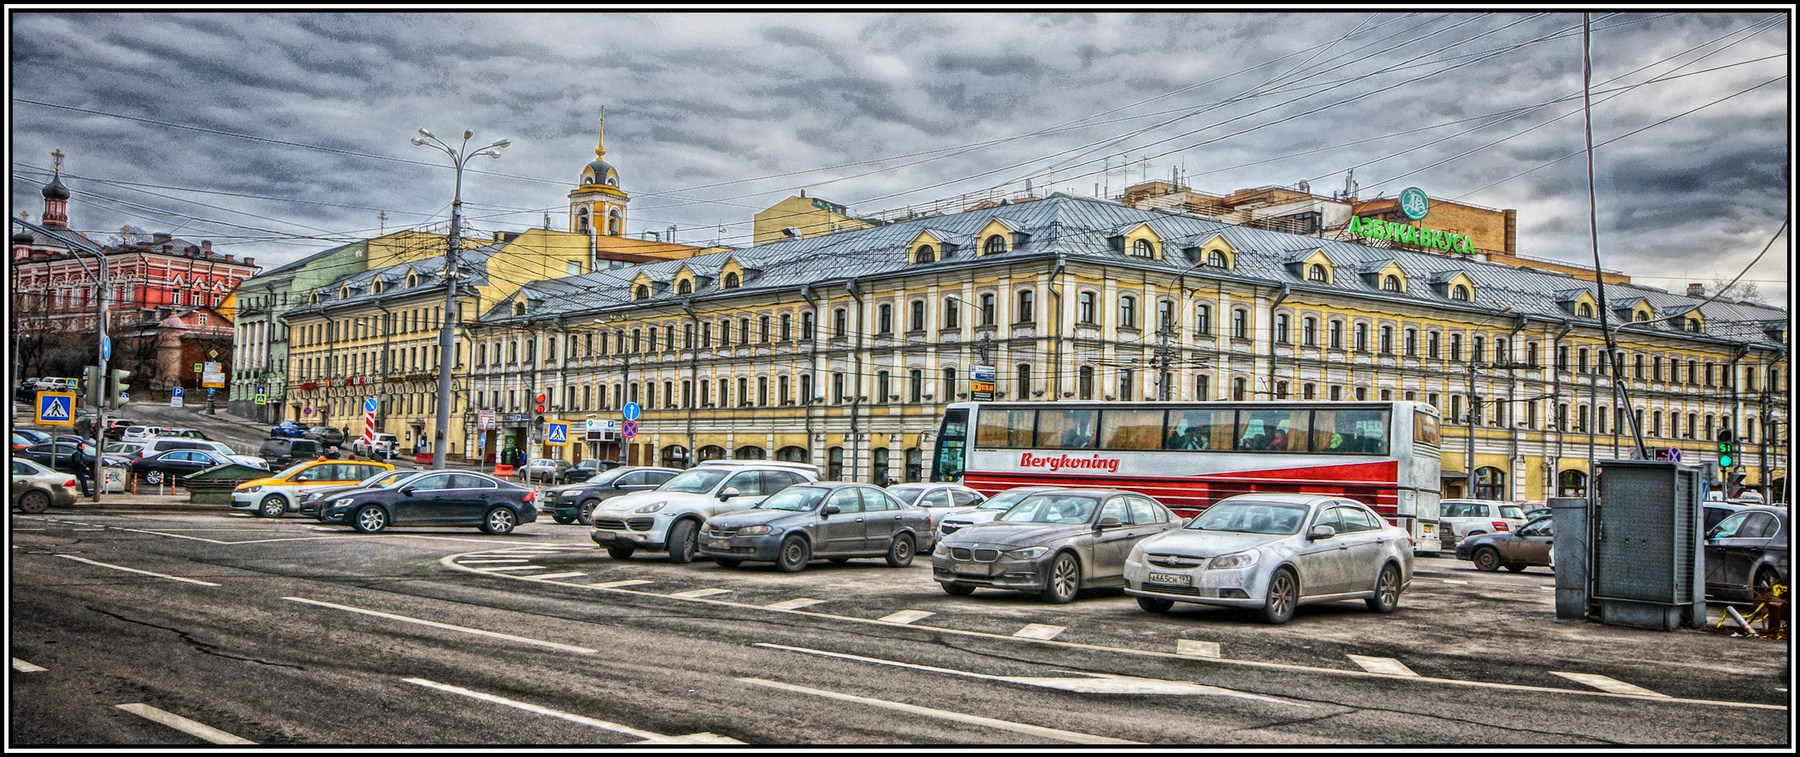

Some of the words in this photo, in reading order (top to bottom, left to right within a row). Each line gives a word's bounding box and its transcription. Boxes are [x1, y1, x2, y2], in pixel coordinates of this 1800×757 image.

[1348, 215, 1419, 245] АЗБУКА
[1420, 227, 1476, 254] ВКУСА
[1020, 452, 1120, 473] Bergkoning
